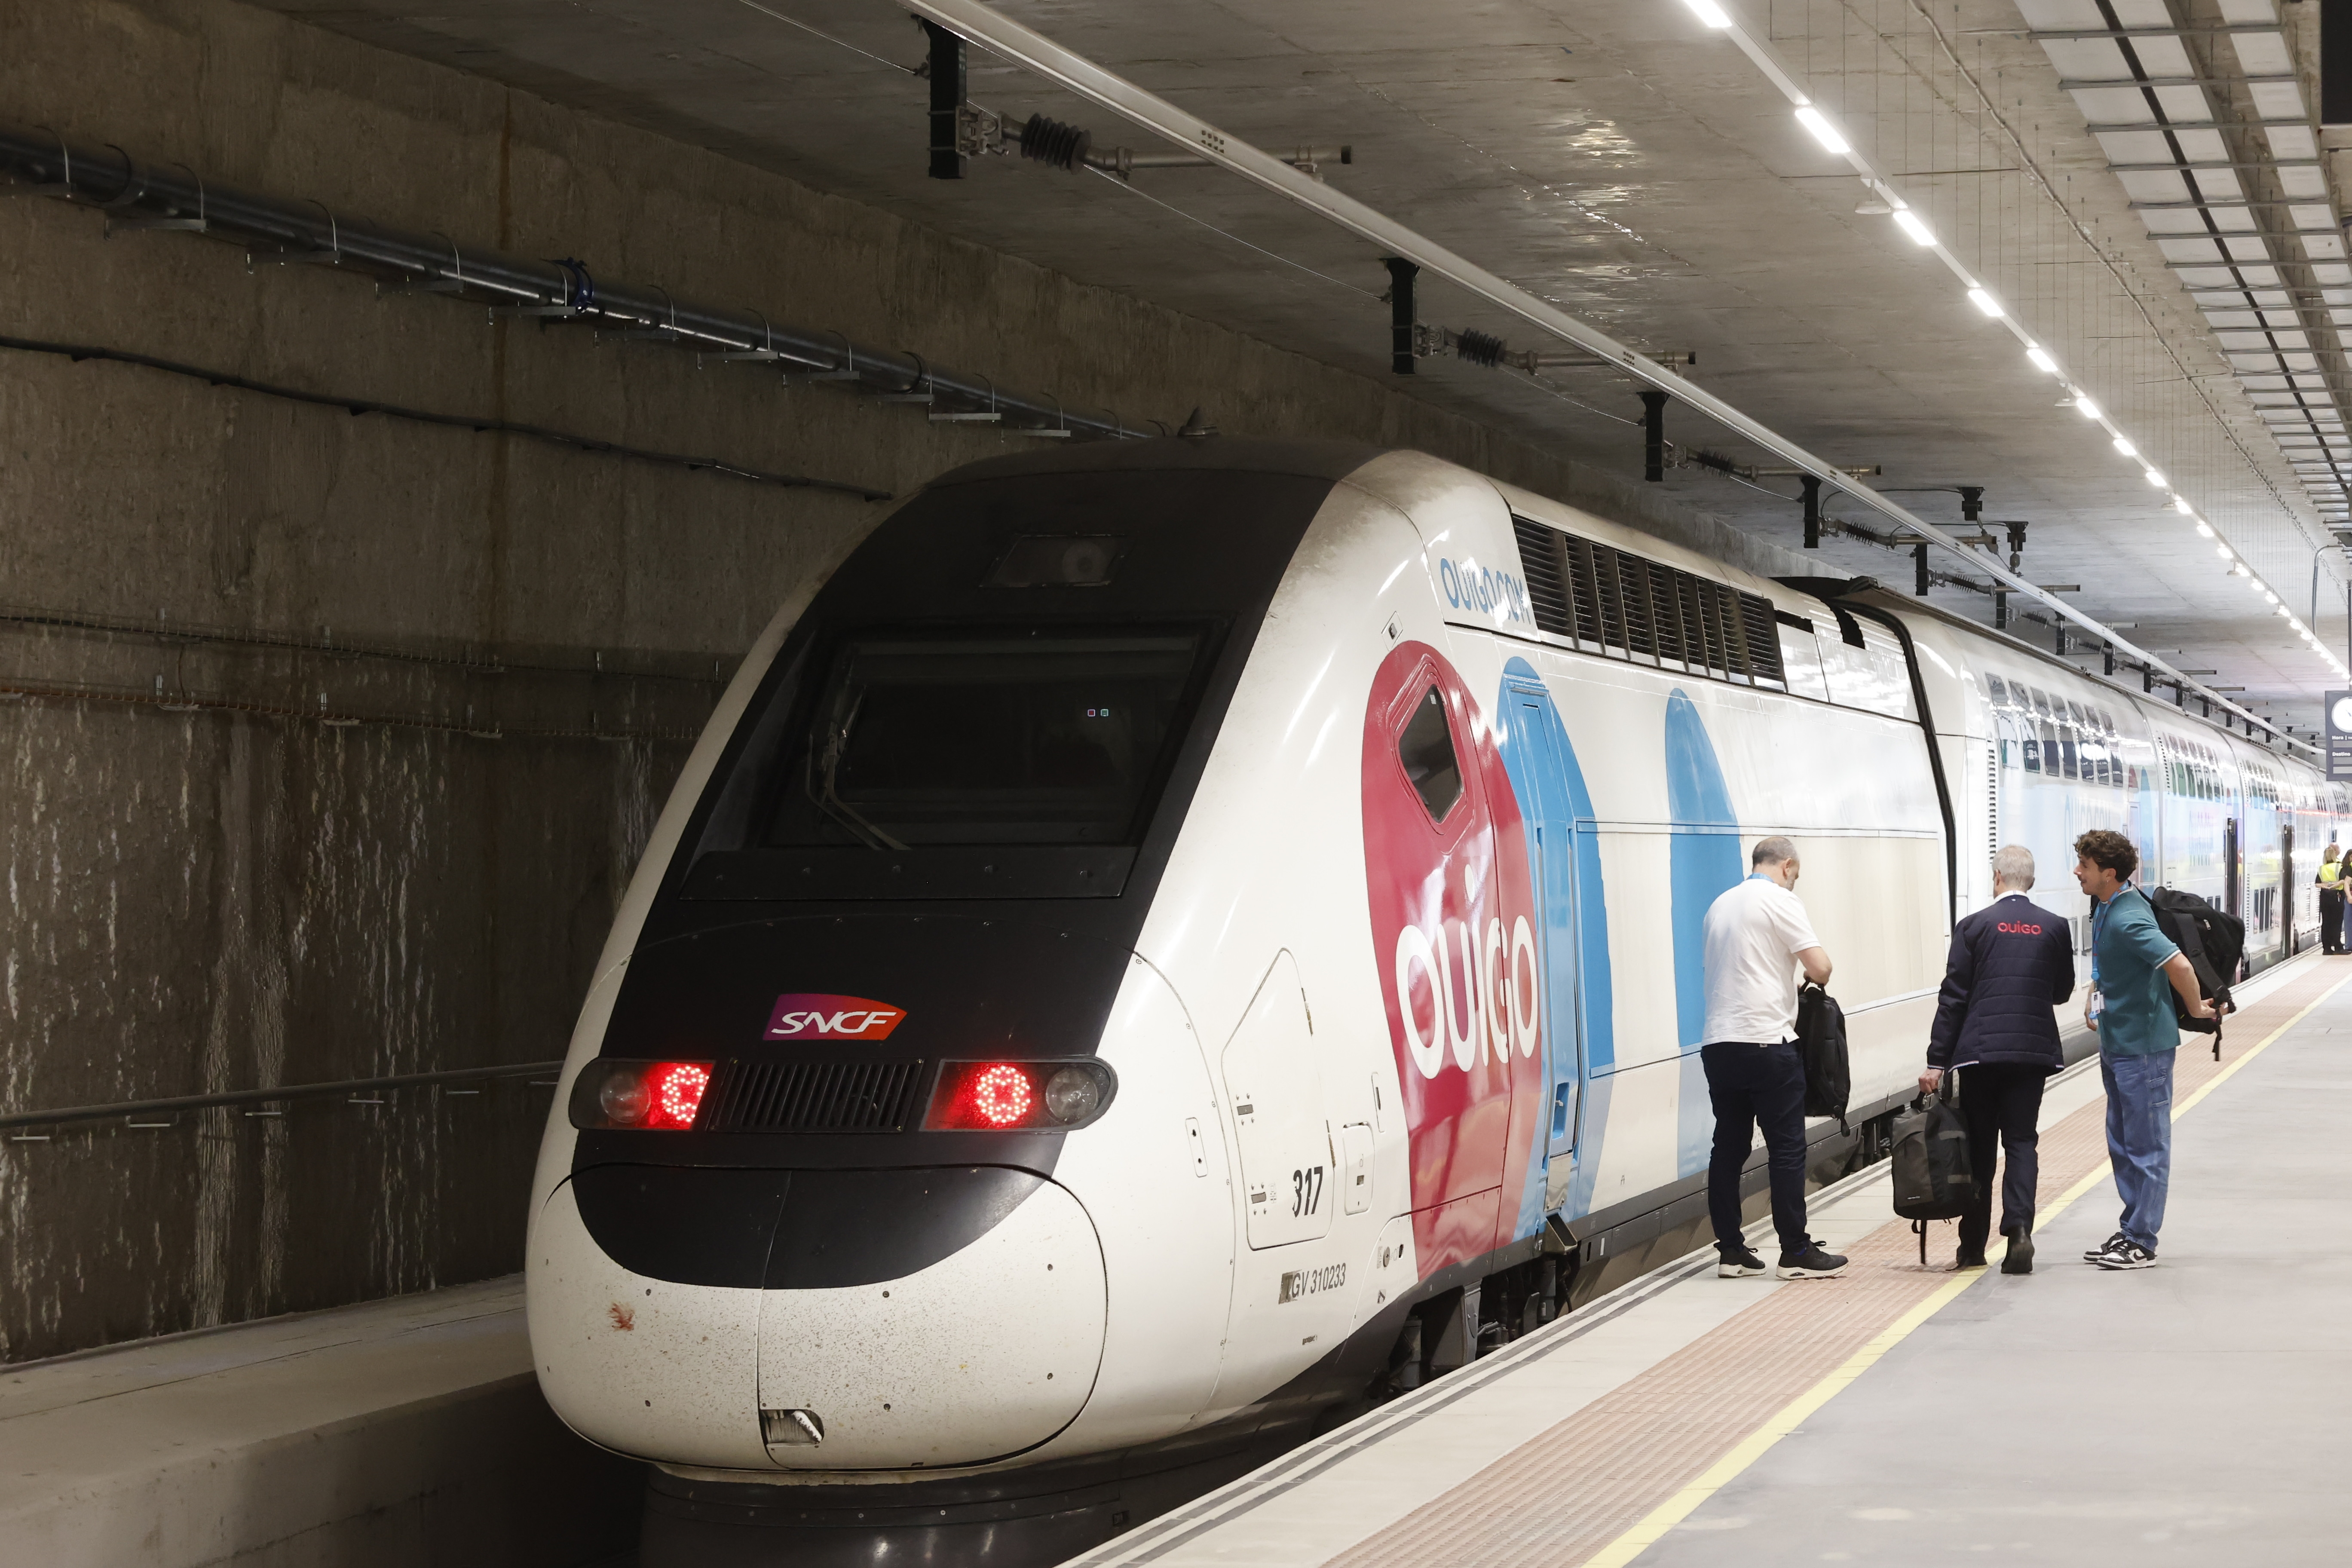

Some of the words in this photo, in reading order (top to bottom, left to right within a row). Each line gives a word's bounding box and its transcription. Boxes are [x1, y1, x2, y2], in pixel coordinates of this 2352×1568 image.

[771, 1011, 897, 1034] SNCF
[1292, 1166, 1323, 1218] 317
[1285, 1271, 1310, 1299] TGV
[1311, 1262, 1346, 1294] 310233
